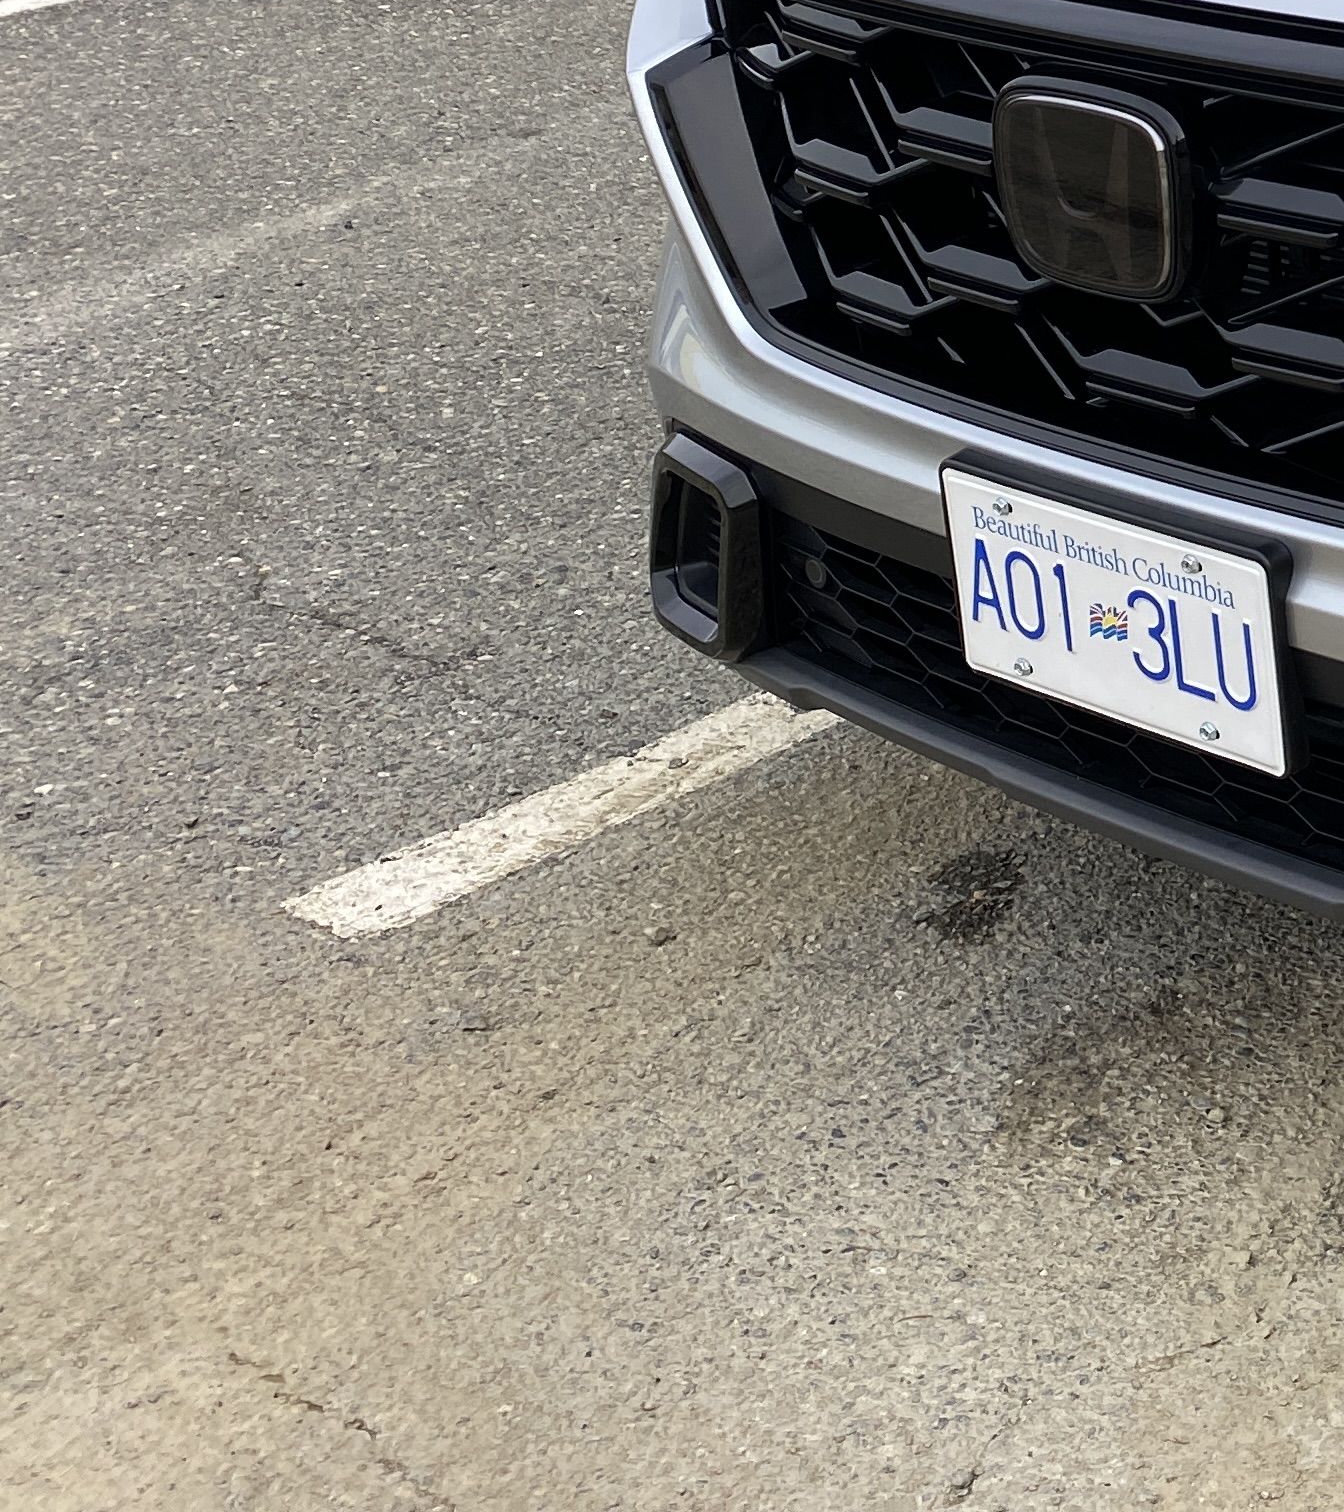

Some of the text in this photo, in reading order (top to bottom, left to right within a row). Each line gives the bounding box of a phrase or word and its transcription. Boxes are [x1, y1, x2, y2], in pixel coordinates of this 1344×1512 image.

[972, 506, 1236, 609] Beautiful British Columbia
[1126, 589, 1258, 712] 3LU
